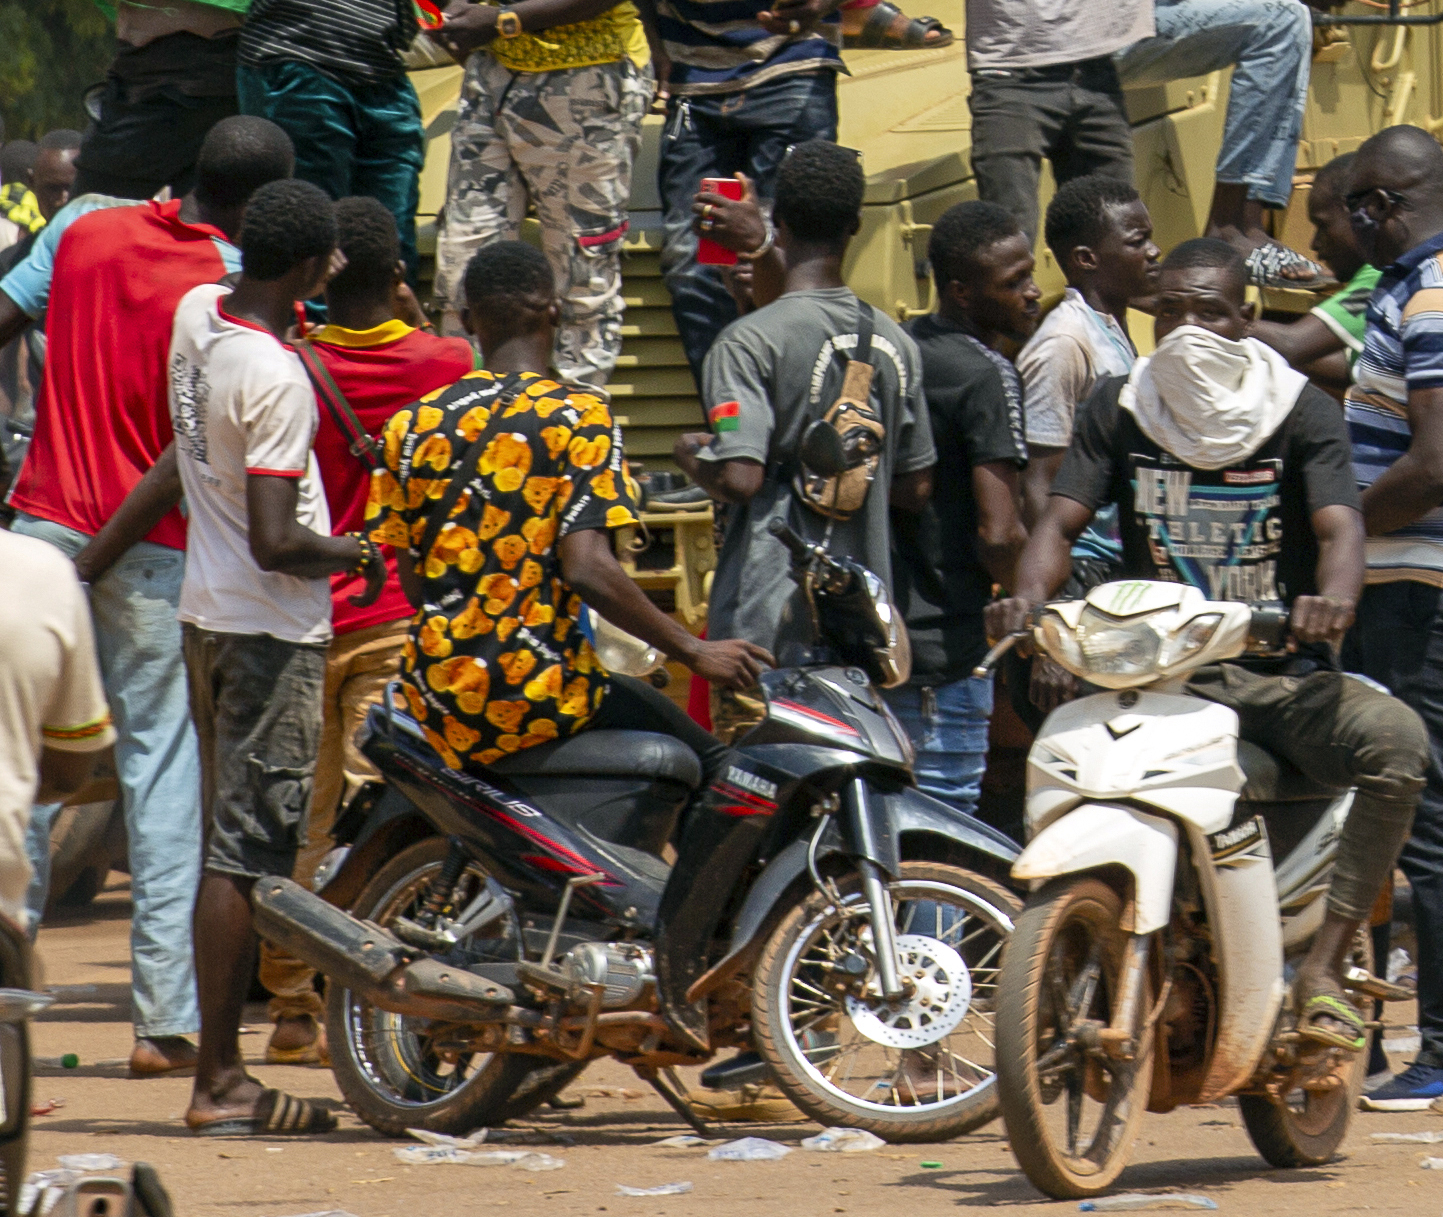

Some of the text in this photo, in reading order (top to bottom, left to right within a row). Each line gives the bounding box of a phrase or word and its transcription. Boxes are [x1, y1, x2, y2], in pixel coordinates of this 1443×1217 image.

[1134, 466, 1193, 517] NEW
[1208, 559, 1280, 601] YORK
[440, 767, 543, 818] SIRIUS
